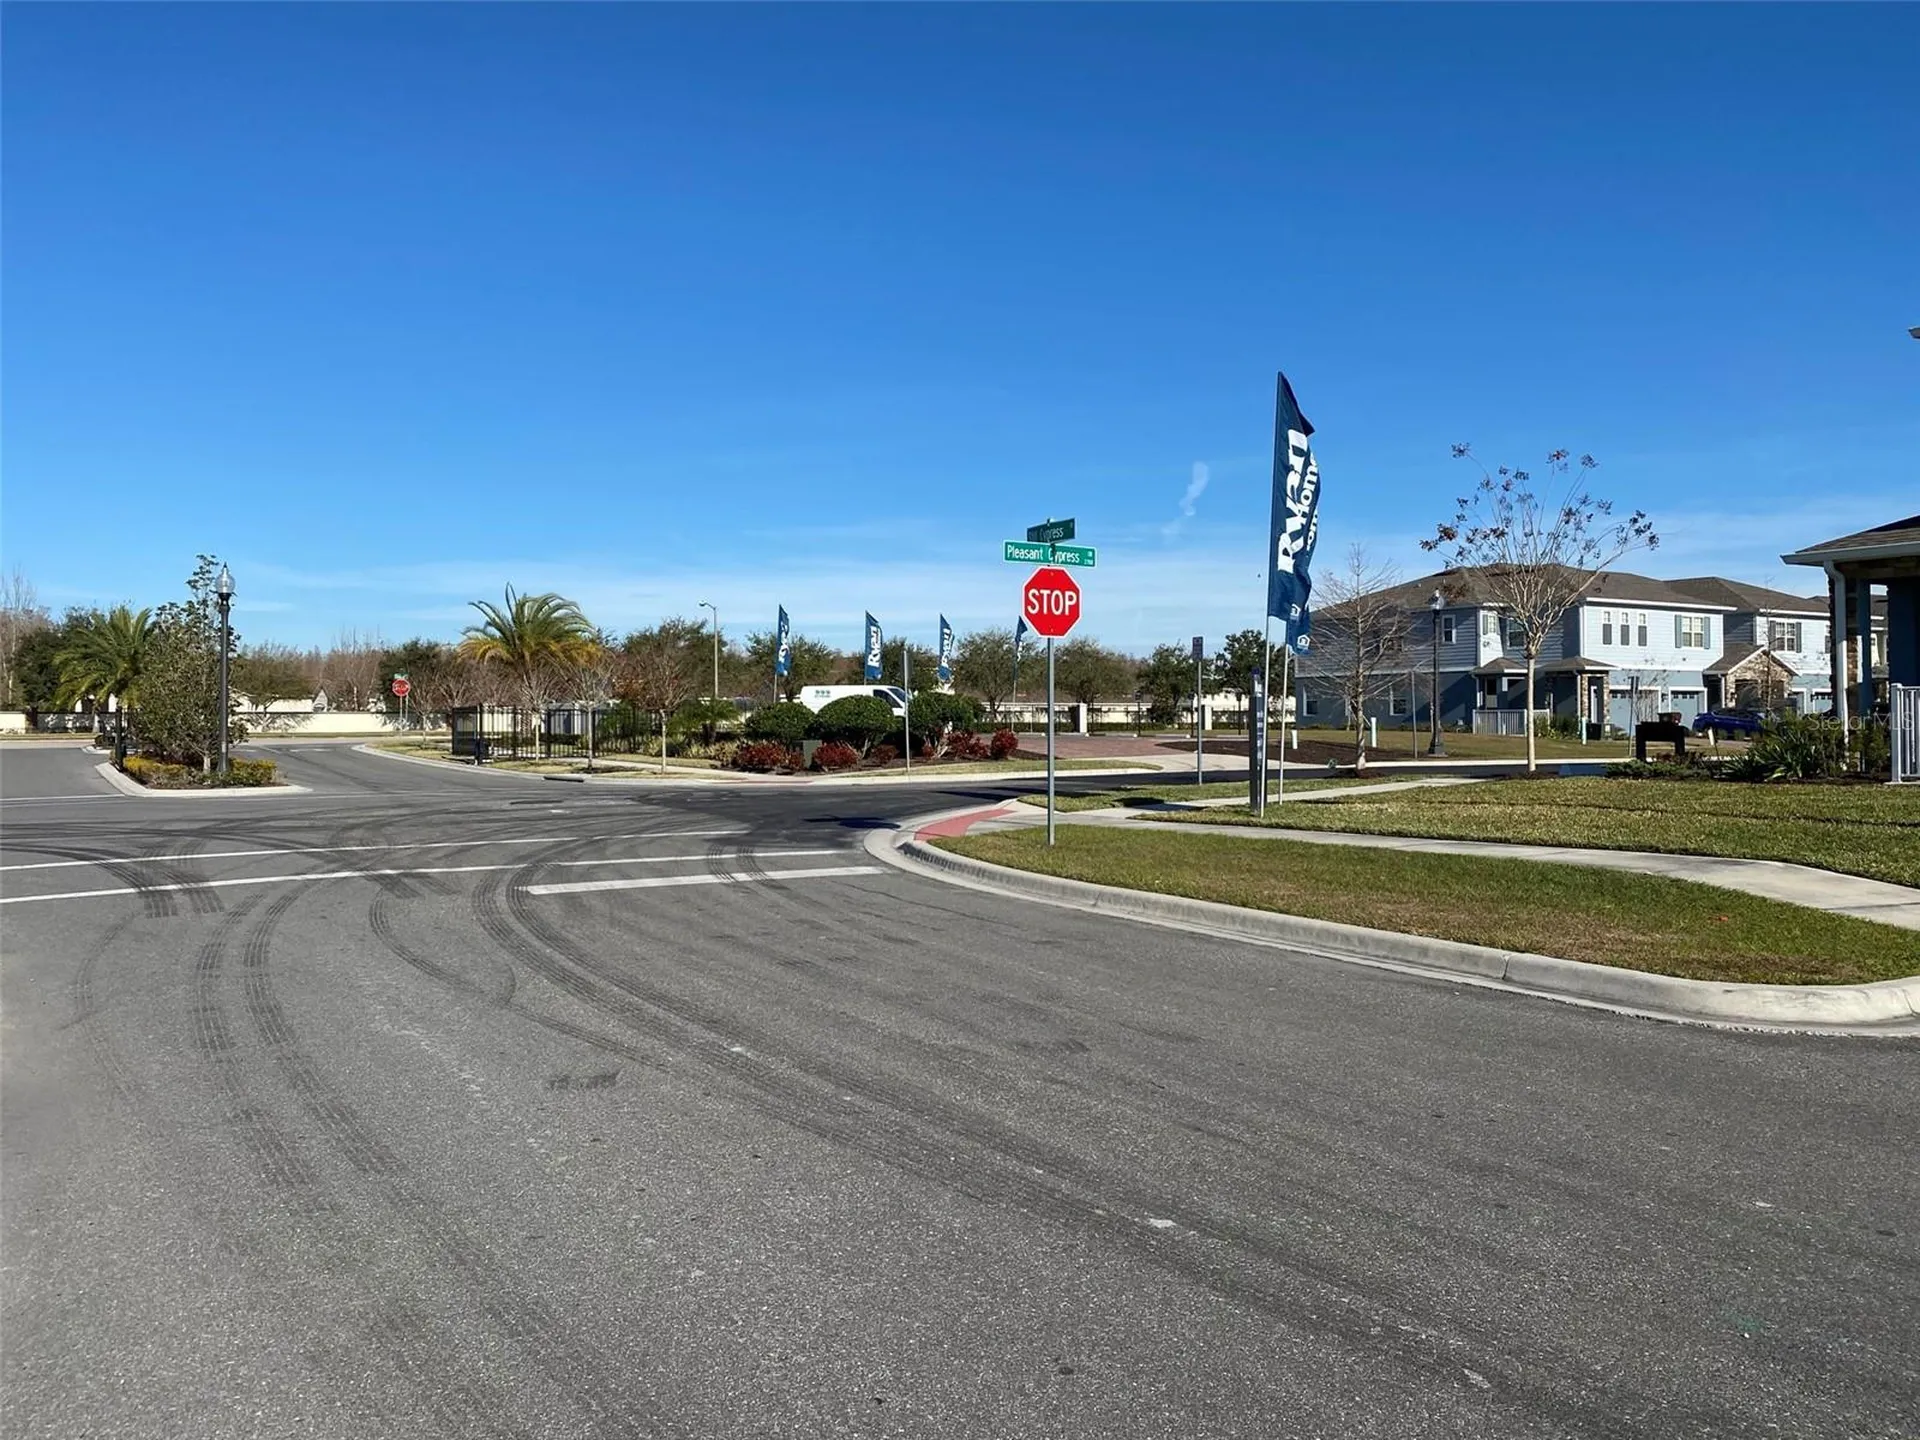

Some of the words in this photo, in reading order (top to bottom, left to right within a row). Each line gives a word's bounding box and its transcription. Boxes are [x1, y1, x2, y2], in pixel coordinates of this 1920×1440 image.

[1278, 429, 1308, 574] Ryan
[1007, 545, 1043, 560] Pleasant
[1027, 588, 1077, 615] STOP
[868, 625, 881, 667] Ryan
